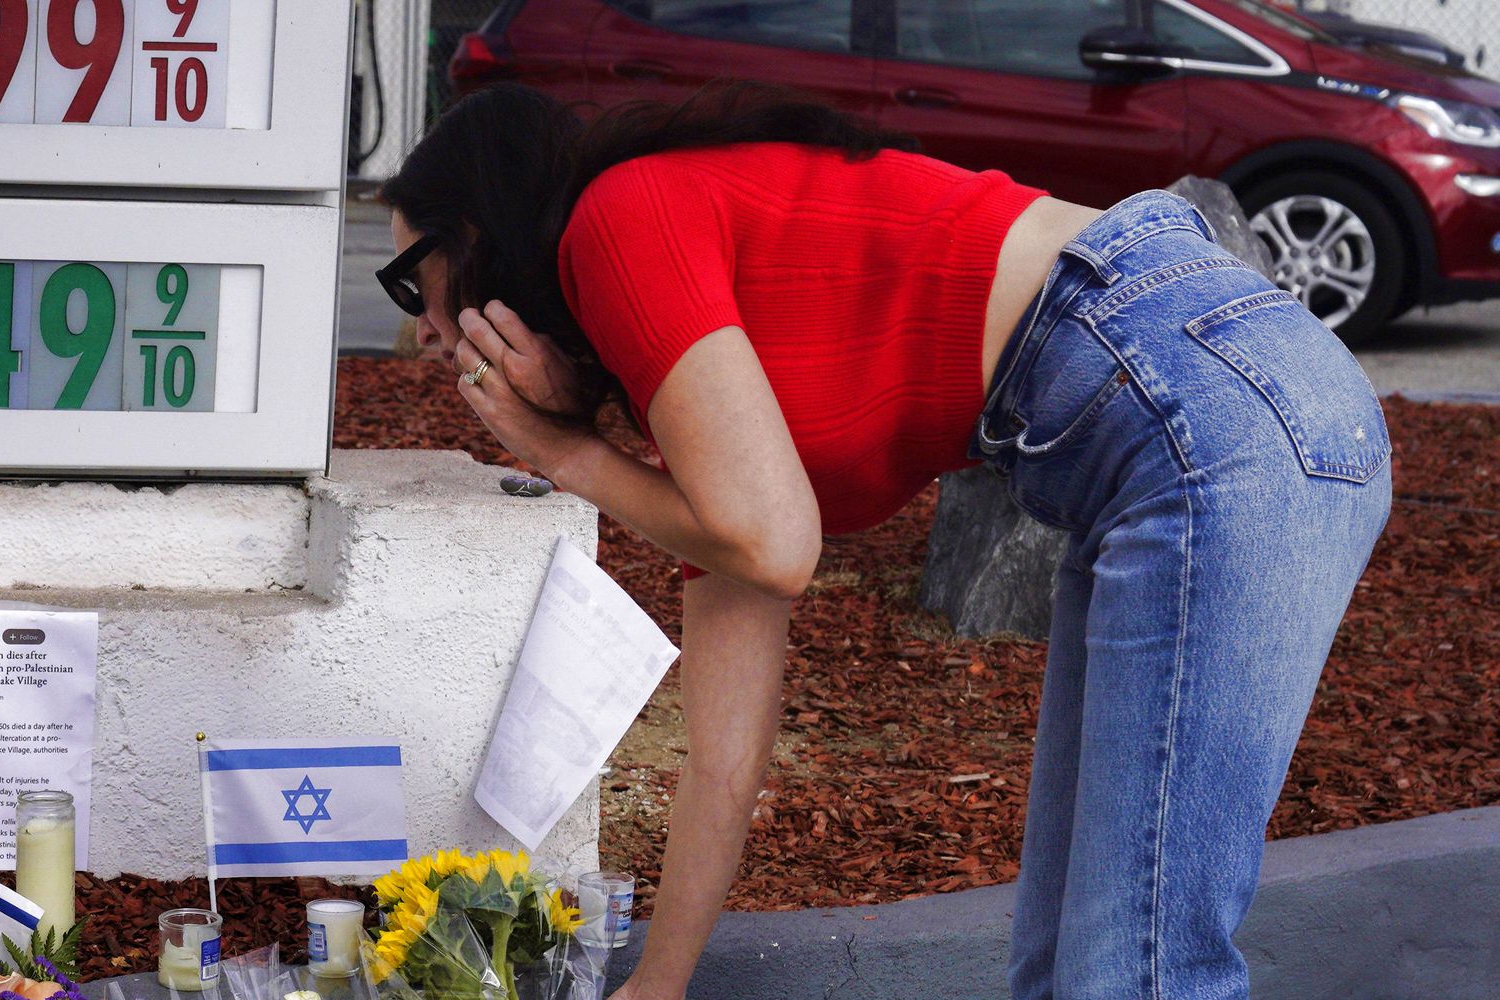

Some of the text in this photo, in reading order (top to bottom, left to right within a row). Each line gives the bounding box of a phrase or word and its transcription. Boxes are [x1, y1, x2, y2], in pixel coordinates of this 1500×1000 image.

[150, 57, 209, 123] 10
[156, 263, 189, 326] 9
[140, 345, 196, 408] 10
[6, 650, 23, 659] dies
[25, 650, 47, 660] after
[6, 663, 73, 675] pro-Palestinian
[16, 675, 47, 688] Village
[11, 722, 26, 730] died
[32, 722, 45, 731] day
[46, 722, 63, 730] after
[64, 722, 73, 730] he
[46, 735, 61, 743] pro-
[7, 746, 31, 755] Village,
[5, 776, 14, 784] of
[14, 776, 39, 785] injuries
